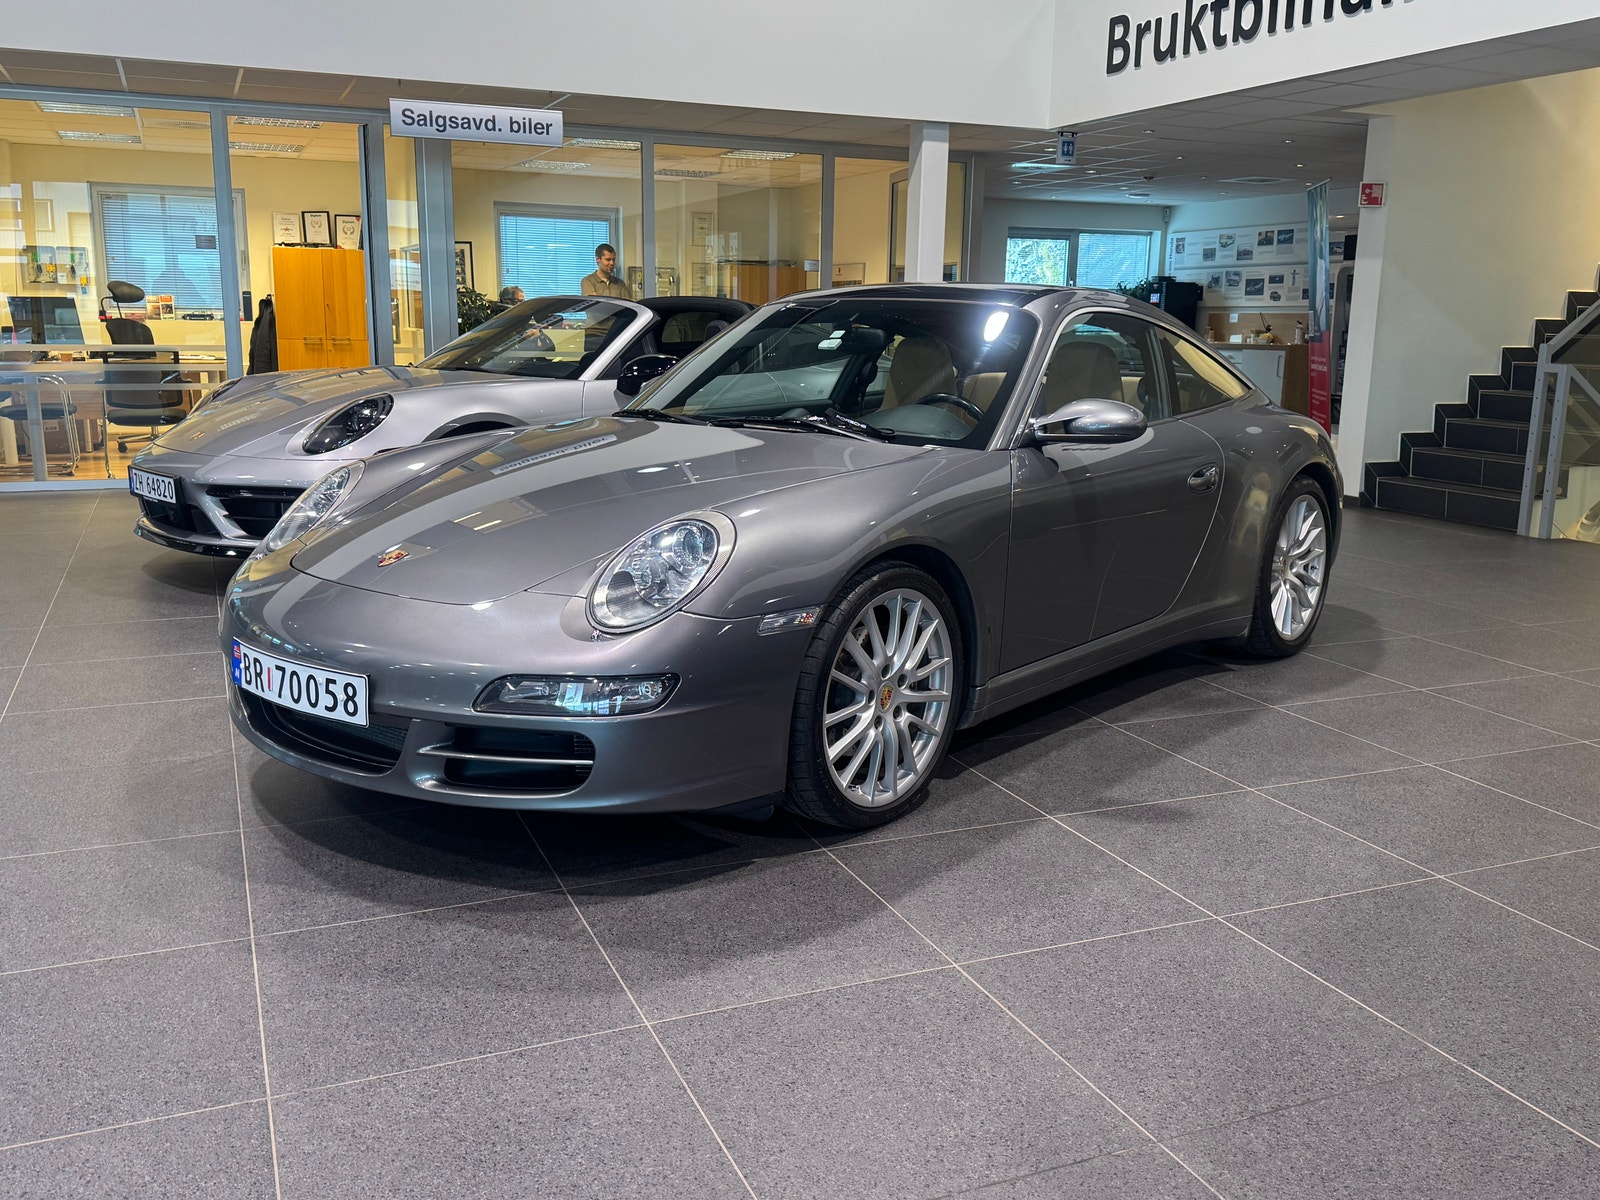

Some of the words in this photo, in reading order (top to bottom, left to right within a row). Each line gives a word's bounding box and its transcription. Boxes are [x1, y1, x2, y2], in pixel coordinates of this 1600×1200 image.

[401, 108, 502, 133] Salgsavd.
[509, 116, 552, 135] biler
[835, 414, 867, 429] PORSCHE
[134, 472, 144, 492] ZH
[146, 476, 174, 499] 64820
[243, 652, 265, 692] BR
[275, 664, 358, 717] 70058
